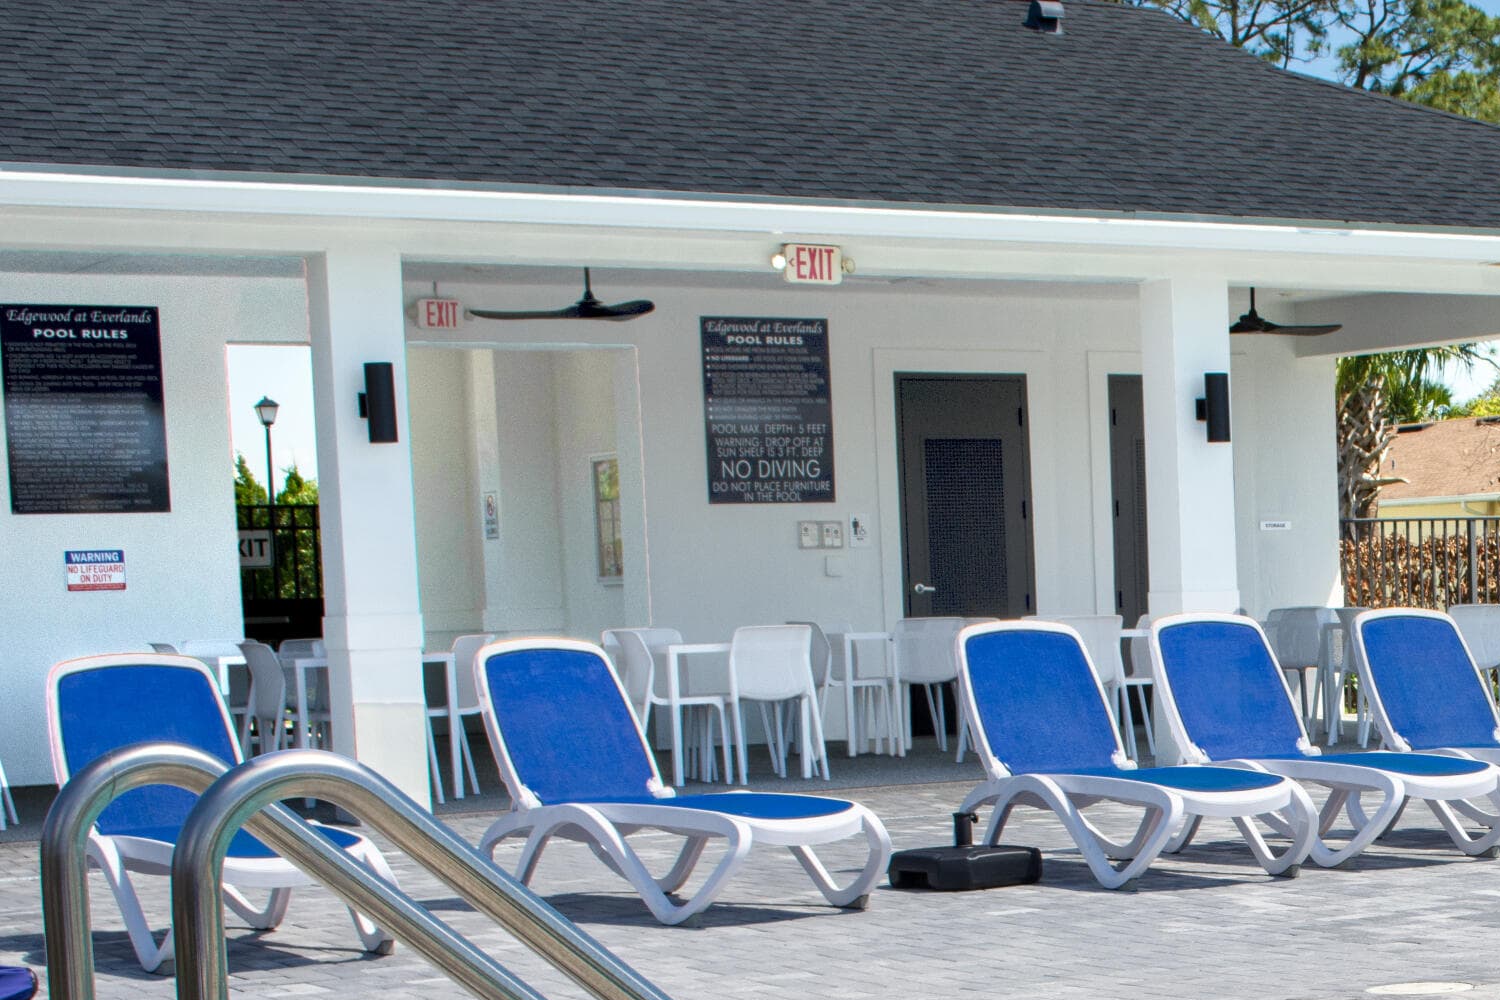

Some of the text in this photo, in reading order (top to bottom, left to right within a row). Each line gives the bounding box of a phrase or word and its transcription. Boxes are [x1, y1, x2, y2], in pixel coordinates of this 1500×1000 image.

[796, 247, 834, 280] EXIT
[6, 308, 152, 325] Edgewood at Everlands
[426, 301, 458, 328] EXIT
[705, 320, 823, 335] Edgewood at Everlands
[32, 328, 128, 339] POOL RULES
[727, 335, 803, 345] POOL RULES
[711, 423, 738, 434] POOL
[799, 424, 804, 433] 5
[807, 423, 826, 434] FEET
[813, 437, 824, 446] AT
[717, 447, 736, 457] SUN
[739, 447, 764, 457] SHELF
[767, 447, 774, 457] IS
[777, 447, 783, 457] 3
[801, 447, 823, 457] DEEP
[721, 459, 821, 479] NO DIVING
[712, 481, 831, 492] DO NOT PLACE FURNITURE
[744, 491, 802, 501] IN THE POOL
[238, 538, 268, 558] XIT
[70, 551, 120, 562] WARNING
[68, 564, 123, 573] NO LIFEGUARD
[80, 574, 112, 582] ON DUTY
